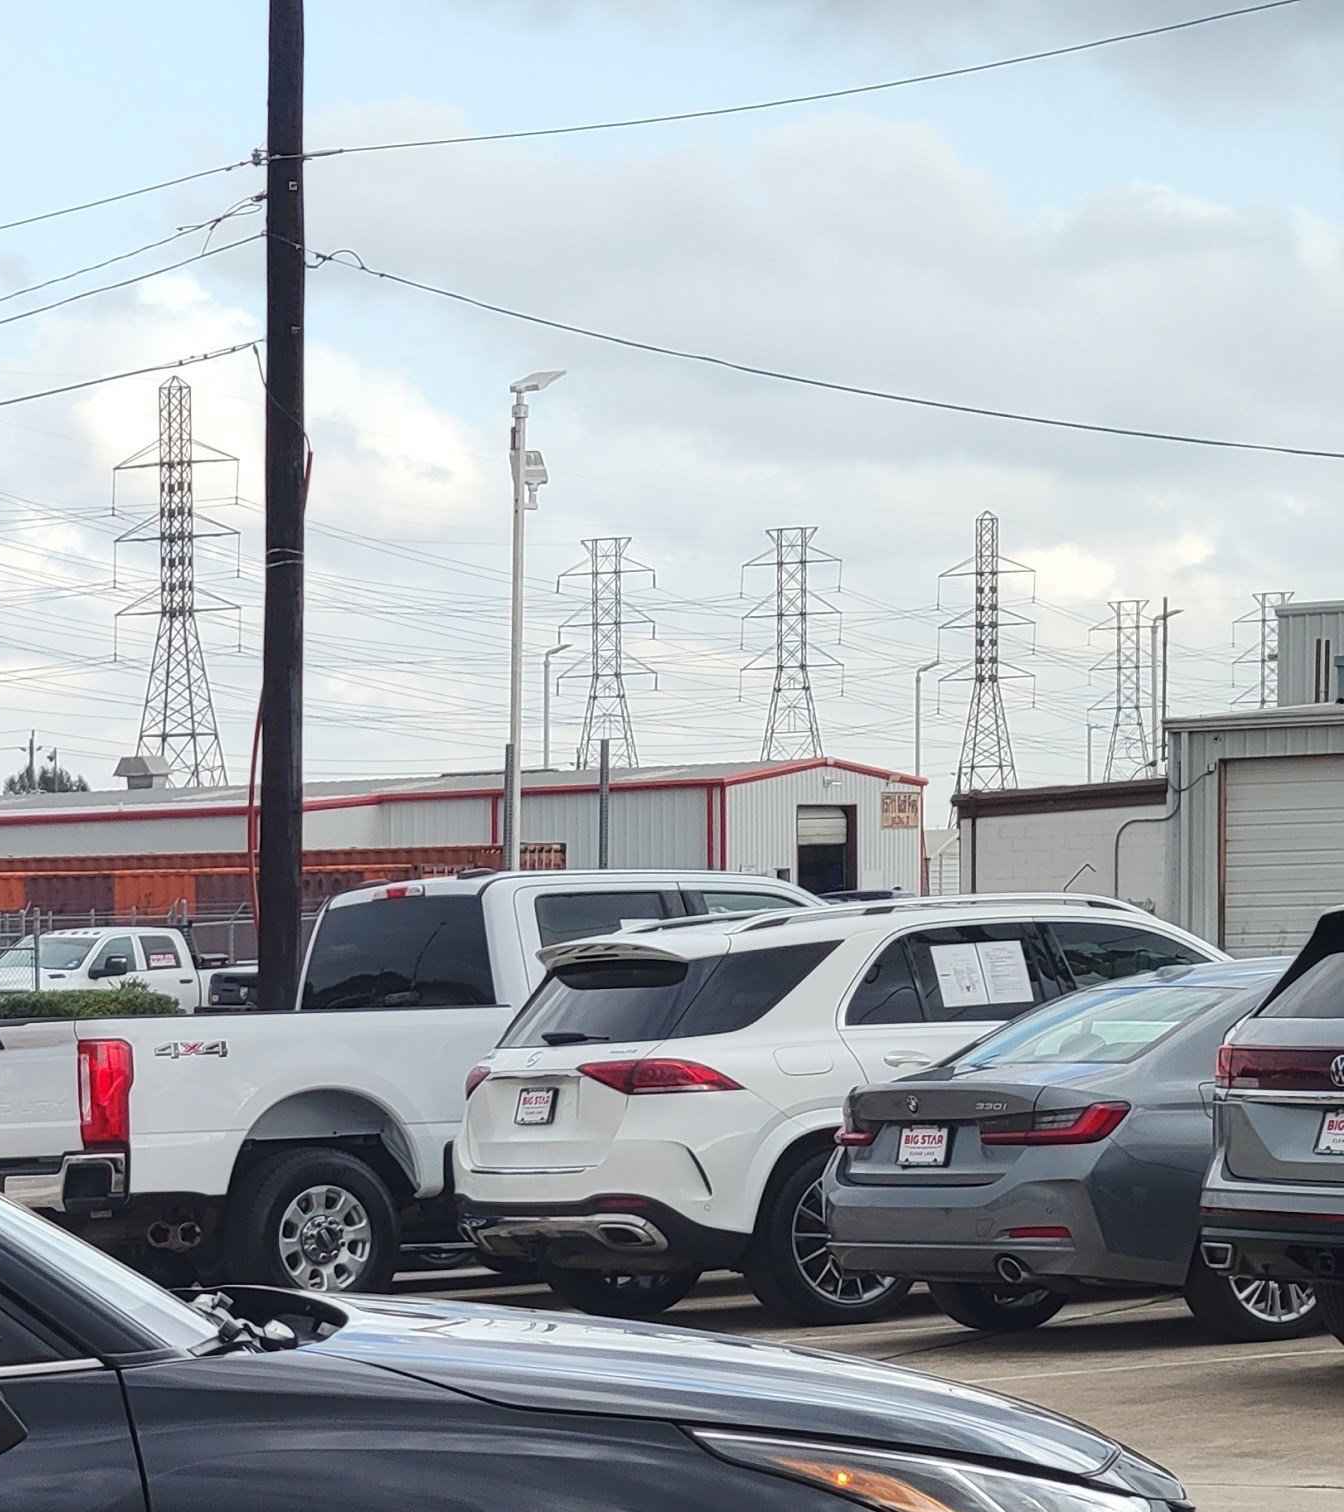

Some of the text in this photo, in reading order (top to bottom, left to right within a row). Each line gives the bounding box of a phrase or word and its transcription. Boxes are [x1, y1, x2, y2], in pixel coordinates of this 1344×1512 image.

[522, 1095, 550, 1105] BIG STAR
[0, 1100, 68, 1115] DUTY
[1327, 1119, 1344, 1131] BIG
[904, 1135, 943, 1145] BIG STAR
